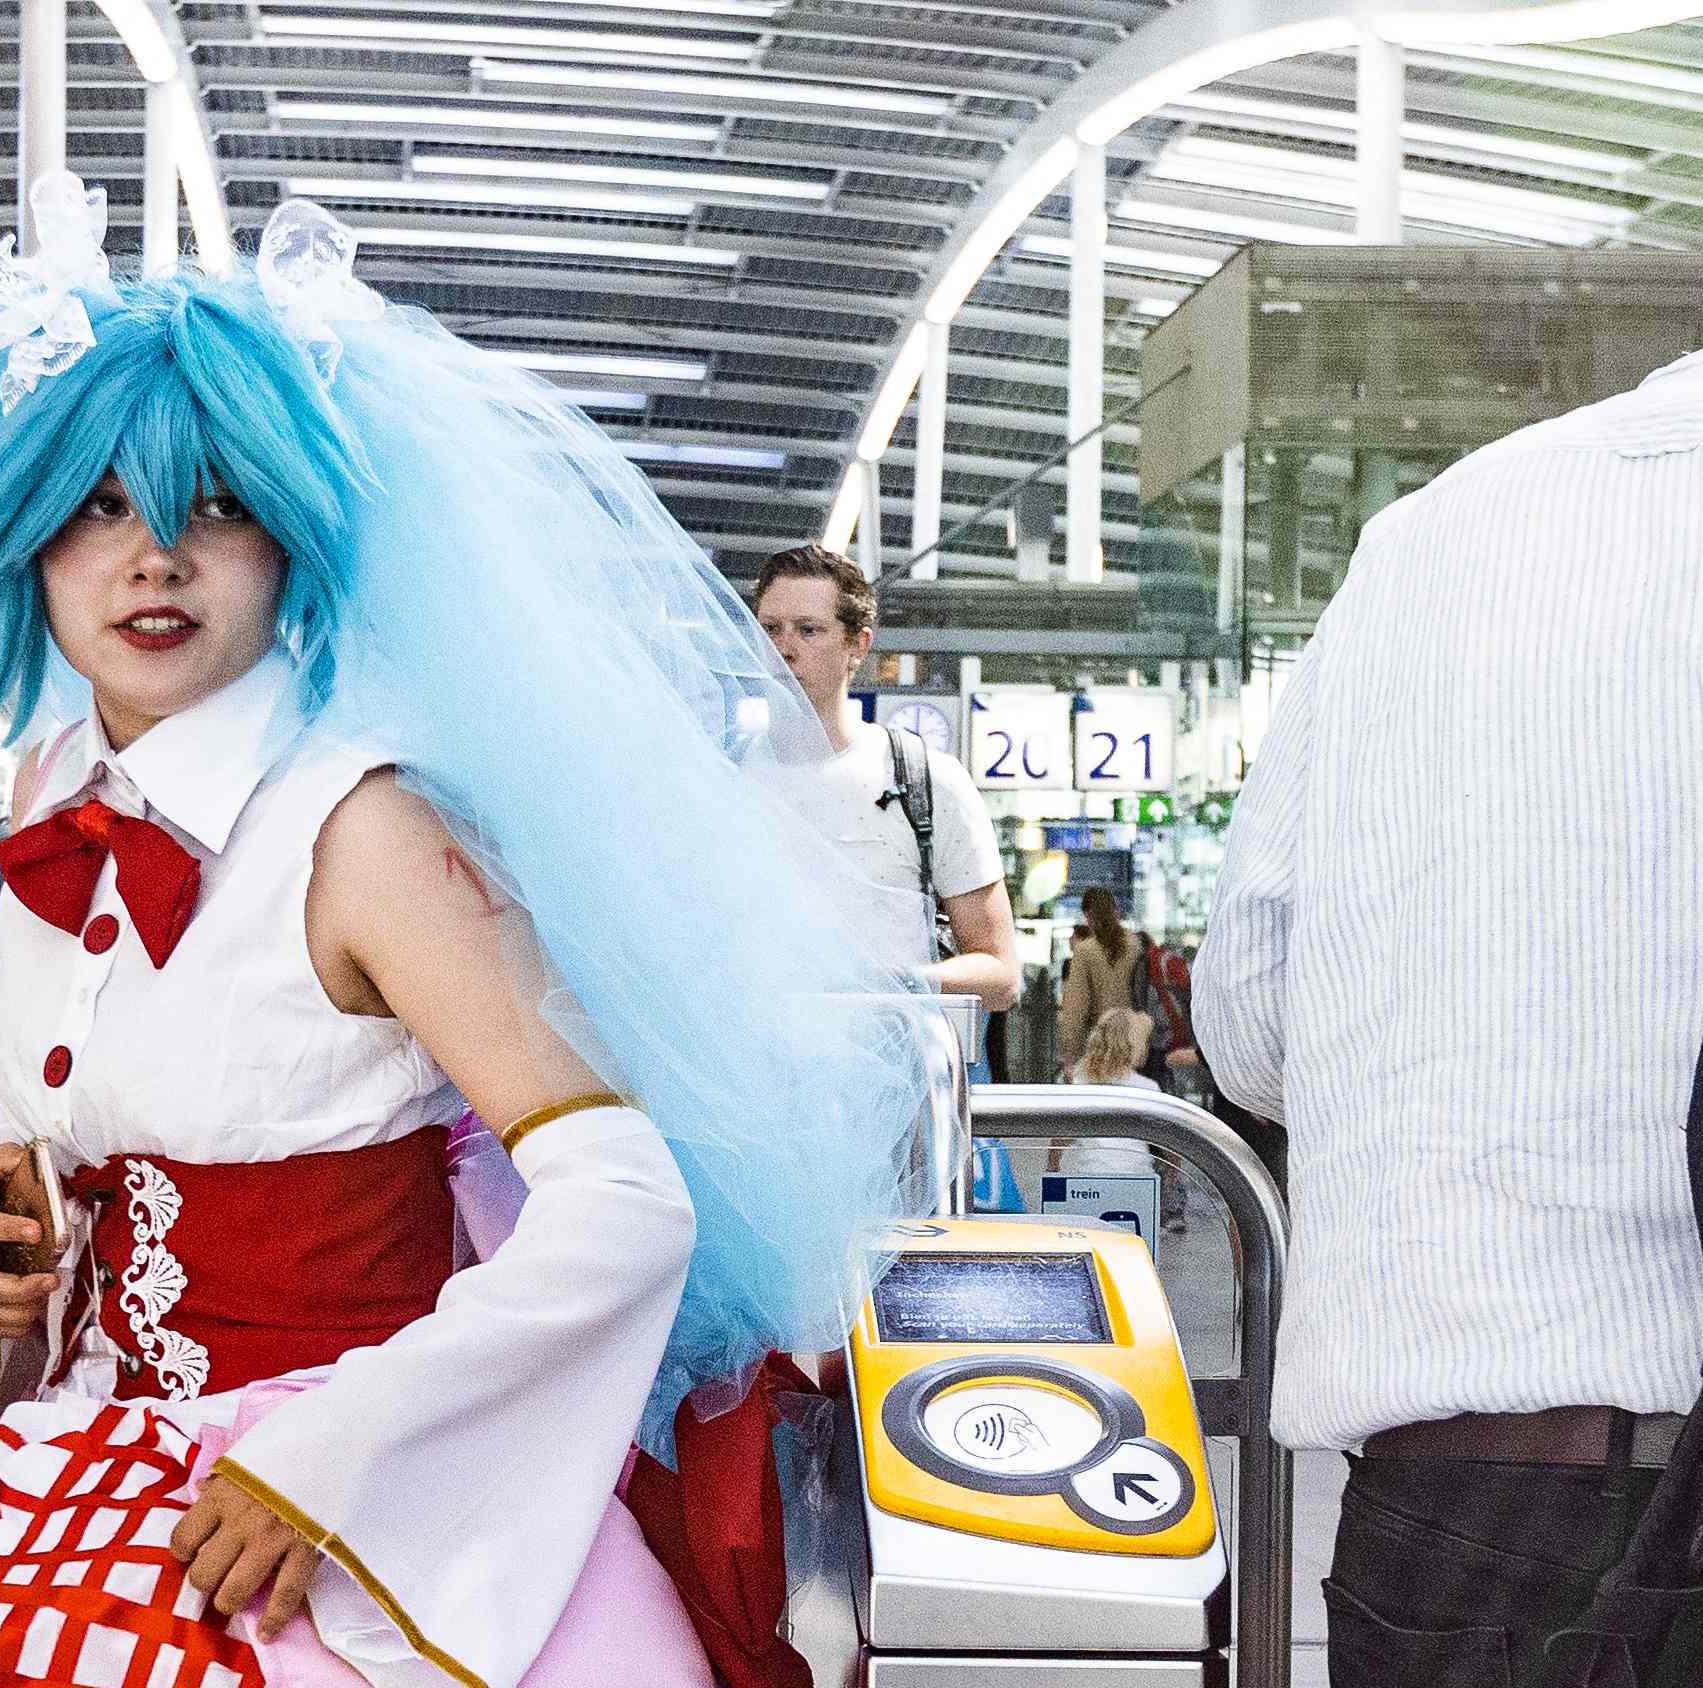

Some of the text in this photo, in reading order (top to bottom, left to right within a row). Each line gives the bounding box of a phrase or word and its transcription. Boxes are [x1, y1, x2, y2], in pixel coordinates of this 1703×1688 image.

[1089, 732, 1152, 780] 21
[1070, 1187, 1100, 1199] trein
[1057, 1231, 1088, 1239] NS
